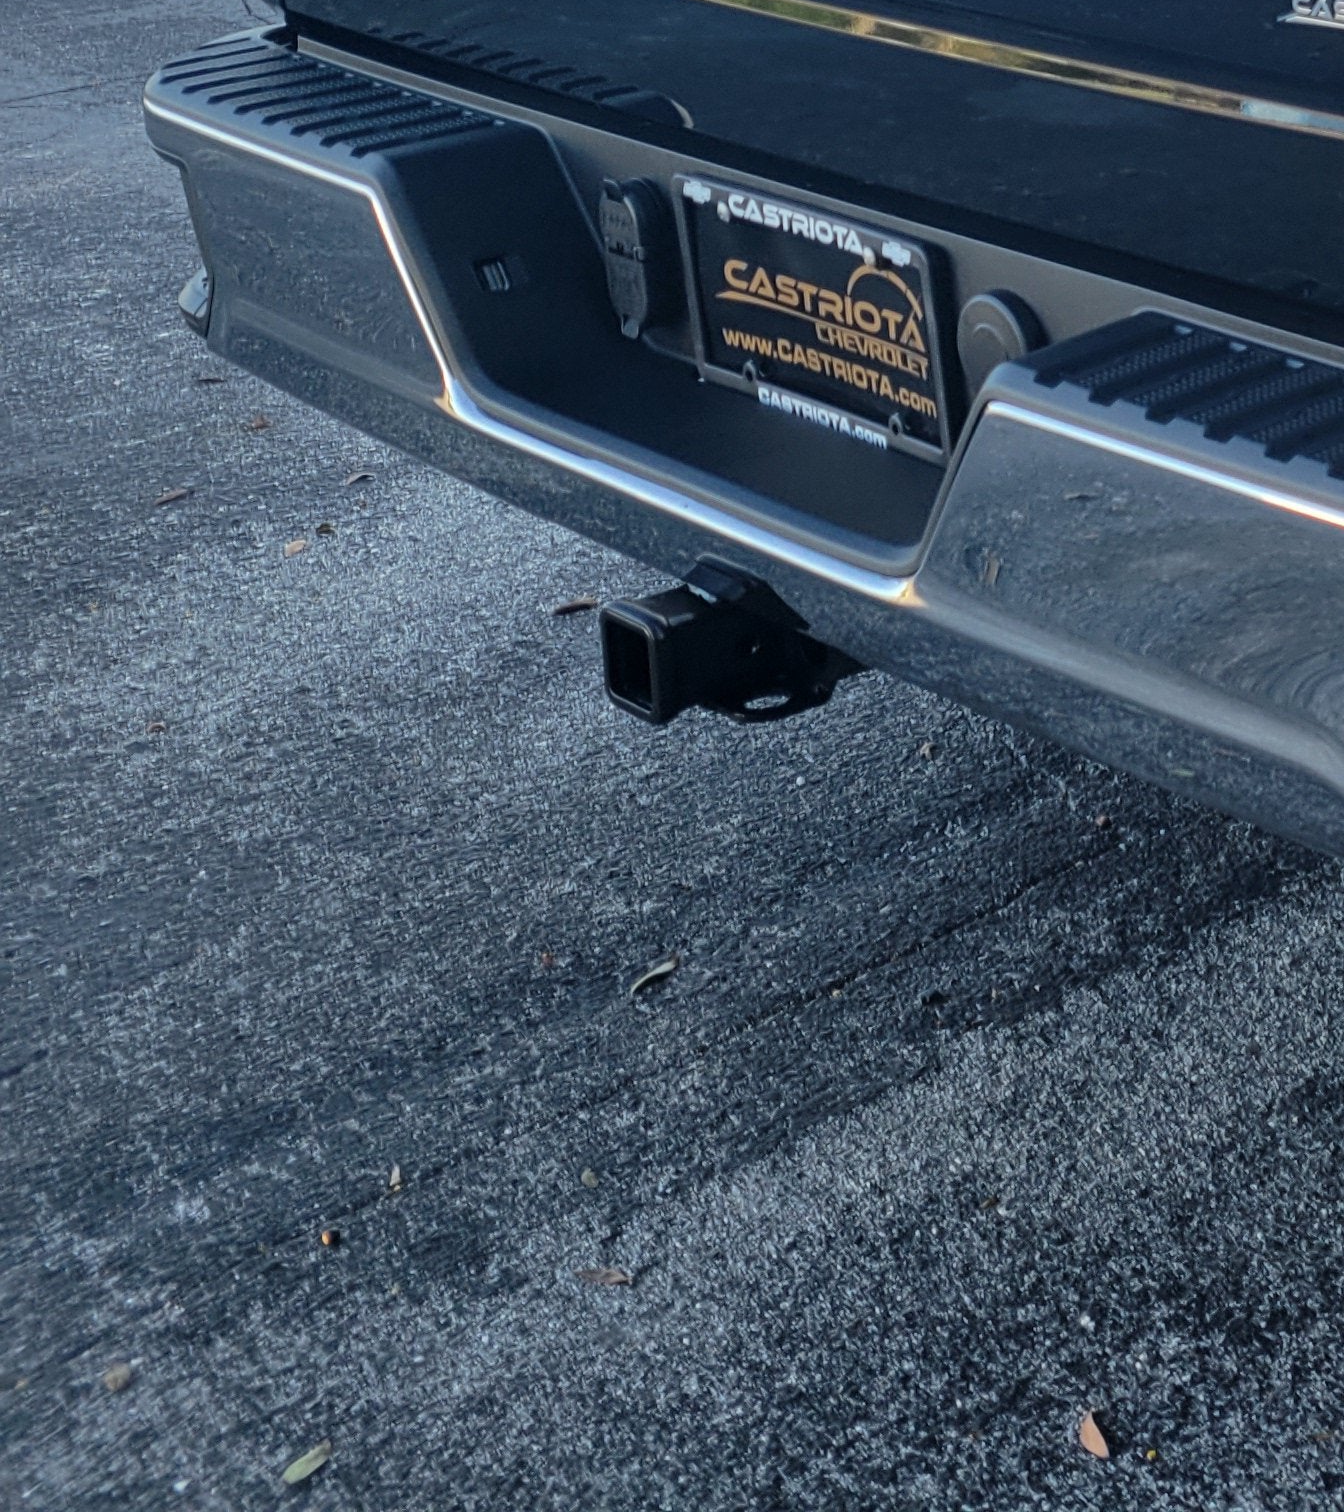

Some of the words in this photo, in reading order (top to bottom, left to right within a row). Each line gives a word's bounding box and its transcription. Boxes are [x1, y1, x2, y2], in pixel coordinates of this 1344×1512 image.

[726, 194, 865, 257] CASTRIOTA
[723, 259, 926, 352] CASTRIOTA
[722, 328, 937, 419] www.CASTRIOTA.com
[816, 322, 929, 381] CHEVROLET
[757, 386, 888, 449] CASTRIOTA.com
